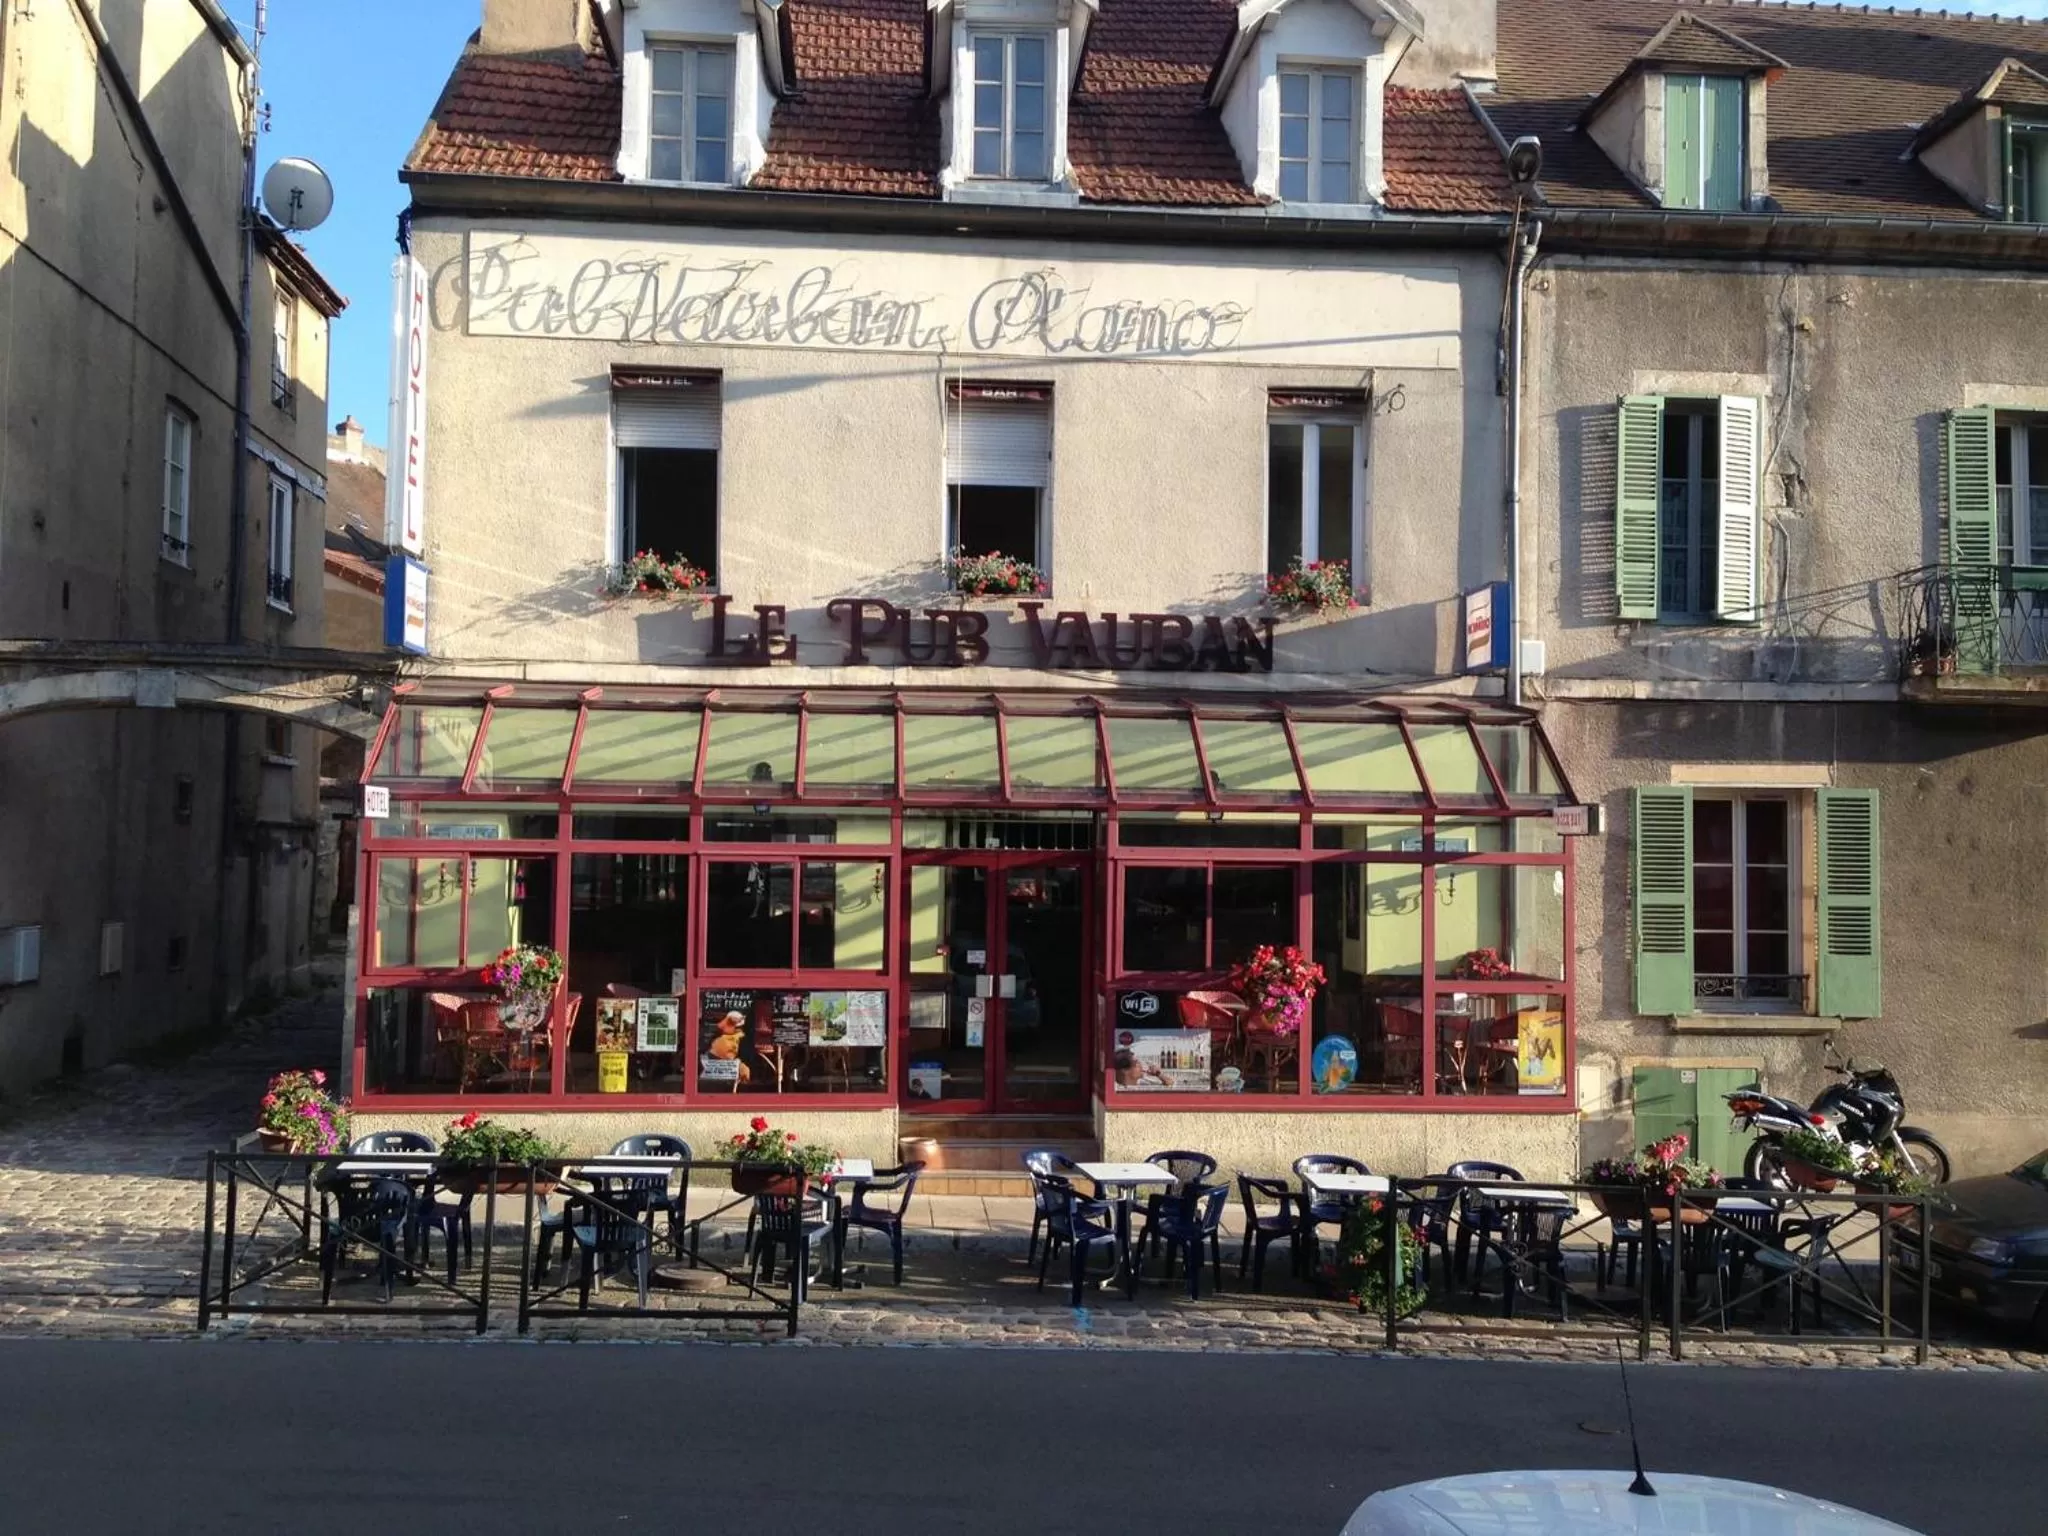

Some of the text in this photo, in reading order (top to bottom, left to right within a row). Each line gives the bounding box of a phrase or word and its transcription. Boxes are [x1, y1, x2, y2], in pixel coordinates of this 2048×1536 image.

[406, 266, 425, 543] HOTEL
[705, 594, 1274, 673] LE PUB VAUBAN
